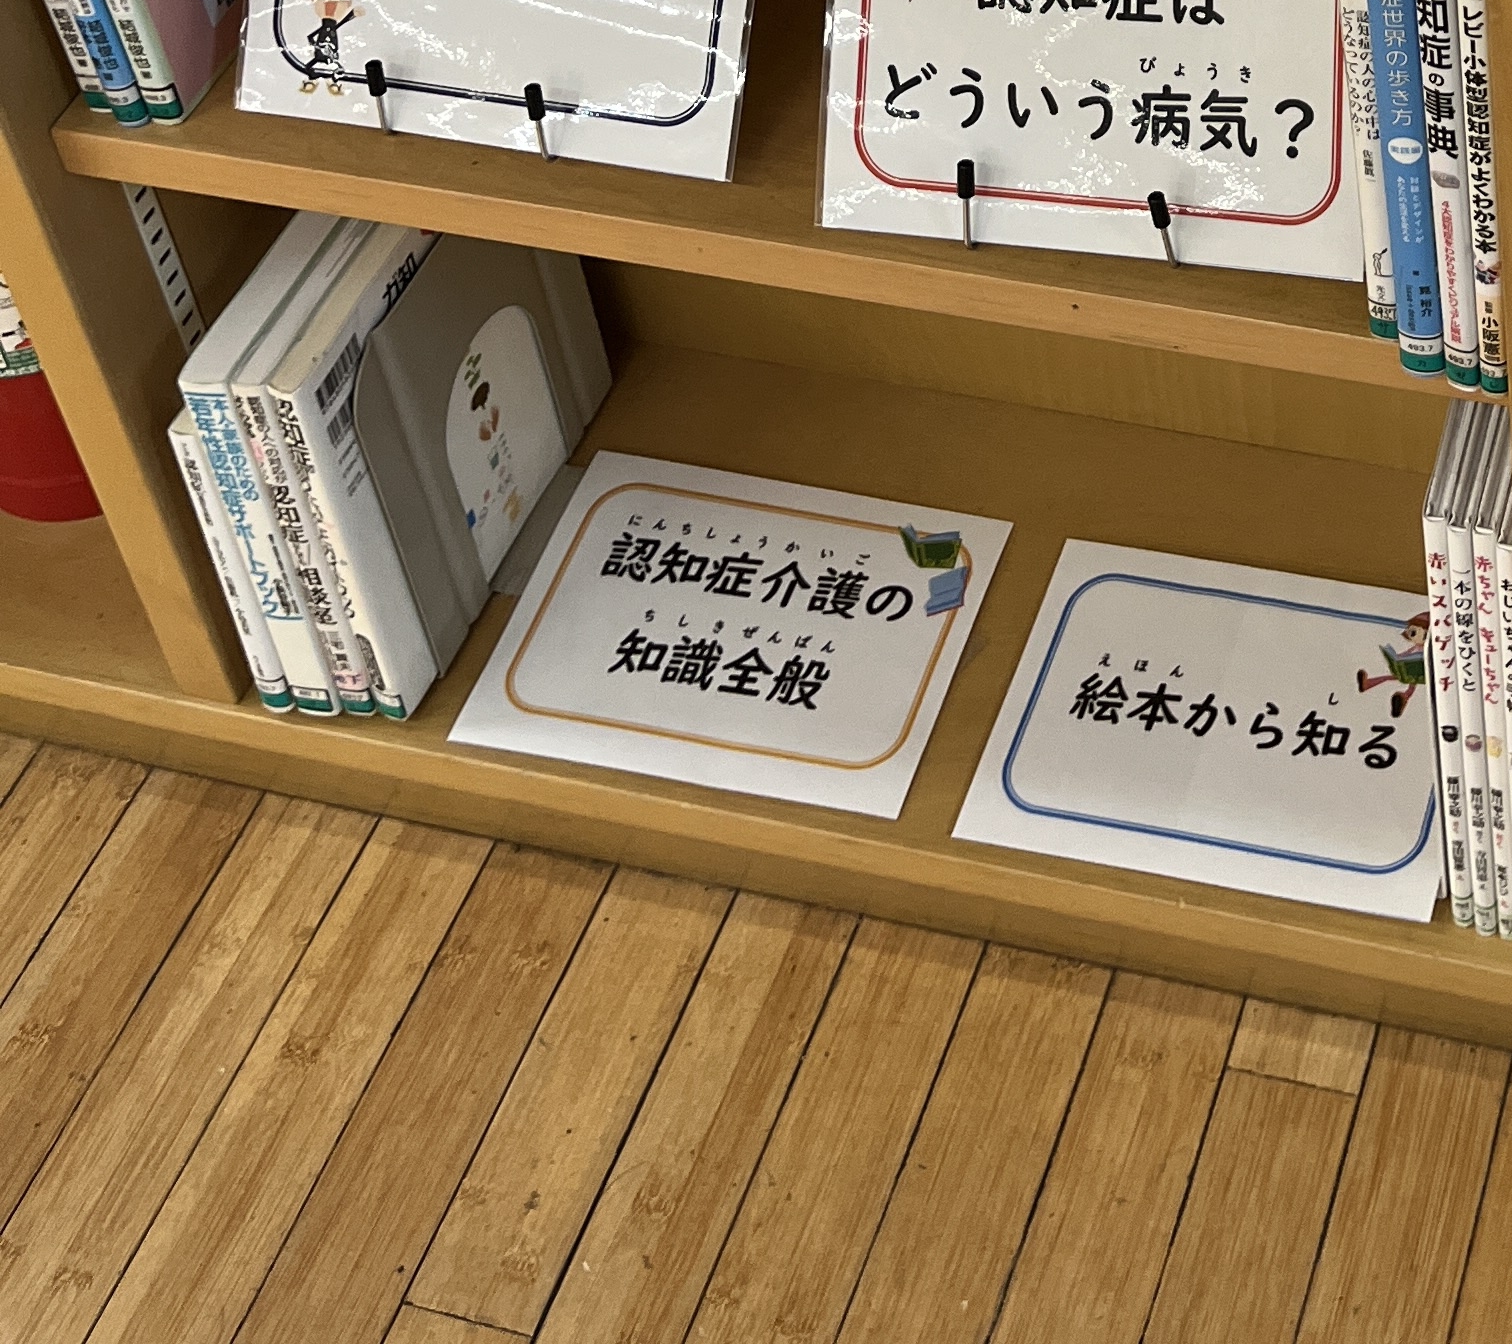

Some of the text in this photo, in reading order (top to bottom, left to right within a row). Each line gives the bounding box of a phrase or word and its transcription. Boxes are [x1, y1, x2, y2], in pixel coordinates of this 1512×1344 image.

[884, 63, 1316, 160] どういう病気？
[600, 533, 917, 623] 認知症介護の
[608, 629, 832, 712] 知識全般
[1069, 671, 1400, 770] 絵本から知る
